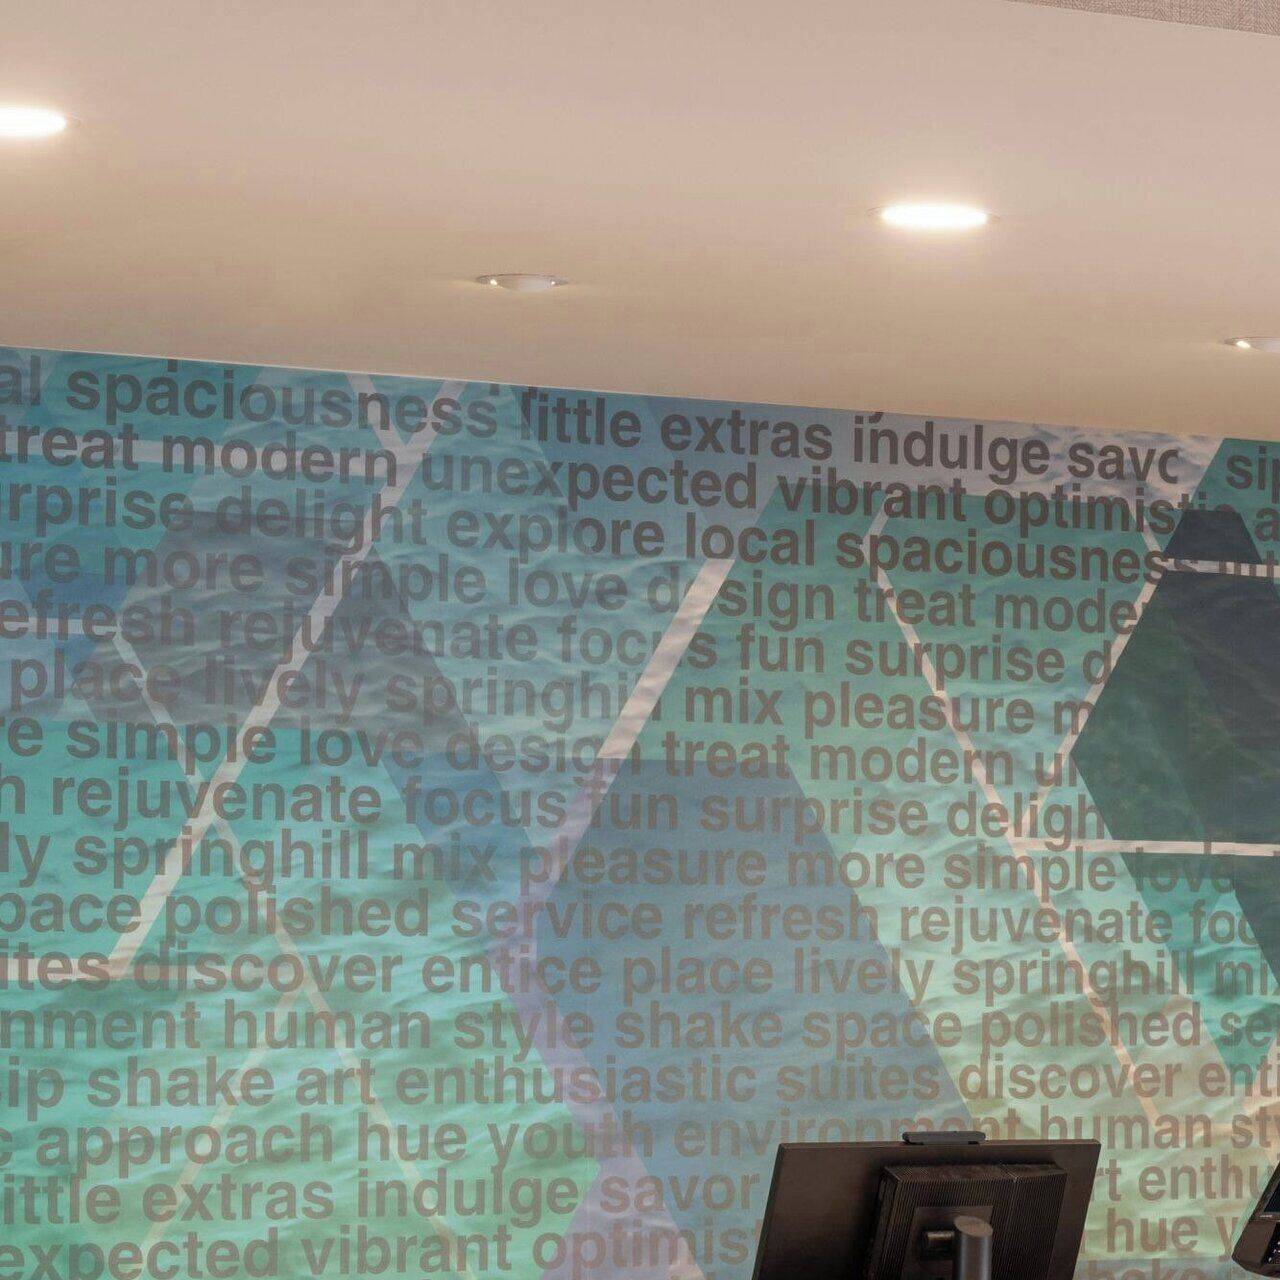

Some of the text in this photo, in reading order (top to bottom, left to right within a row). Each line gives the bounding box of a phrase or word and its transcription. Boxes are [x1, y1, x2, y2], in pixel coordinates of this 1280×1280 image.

[65, 368, 498, 439] spaciousness
[521, 388, 642, 450] little
[661, 408, 834, 461] extras
[853, 415, 1050, 486] indulge
[162, 429, 398, 487] modern
[422, 452, 758, 510] unexpected
[776, 466, 967, 523] vibrant
[217, 485, 427, 556] delight
[446, 505, 666, 564] explore
[686, 512, 815, 567] local
[105, 544, 265, 593] more
[286, 554, 487, 614] simple
[509, 557, 629, 611] love
[853, 575, 977, 629] treat
[219, 600, 539, 664] rejuvenate
[737, 623, 825, 673] fun
[845, 634, 1065, 691] surprise
[11, 647, 183, 712] place
[202, 655, 365, 724] lively
[685, 677, 784, 725] mix
[804, 681, 1035, 739] pleasure
[66, 709, 278, 775] simple
[301, 727, 425, 769] love
[661, 731, 791, 780] treat
[811, 737, 1014, 787] modern
[52, 765, 383, 832] rejuvenate
[404, 775, 567, 829] focus
[701, 786, 929, 845] surprise
[73, 826, 369, 891] springhill
[394, 831, 499, 883] mix
[521, 834, 767, 896] pleasure
[788, 849, 925, 889] more
[944, 842, 1117, 902] simple
[165, 884, 430, 947] polished
[452, 892, 664, 941] service
[684, 892, 879, 942] refresh
[901, 895, 1173, 954] rejuvenate
[134, 939, 403, 994] discover
[422, 945, 601, 995] entice
[622, 946, 774, 1006] place
[794, 946, 935, 1007] lively
[953, 949, 1194, 1007] springhill
[224, 999, 431, 1050] human
[454, 1000, 595, 1062] style
[615, 999, 784, 1050] shake
[802, 1009, 963, 1060] space
[982, 1001, 1200, 1057] polished
[87, 1055, 276, 1108] shake
[296, 1058, 377, 1107] art
[395, 1055, 756, 1107] enthusiastic
[776, 1053, 941, 1102] suites
[958, 1053, 1184, 1101] discover
[36, 1112, 334, 1179] approach
[358, 1111, 467, 1162] hue
[487, 1110, 654, 1168] youth
[1040, 1105, 1214, 1150] human
[142, 1173, 336, 1225] extras
[358, 1167, 578, 1229] indulge
[598, 1172, 762, 1214] savor
[301, 1224, 512, 1277] vibrant
[1106, 1207, 1199, 1253] hue
